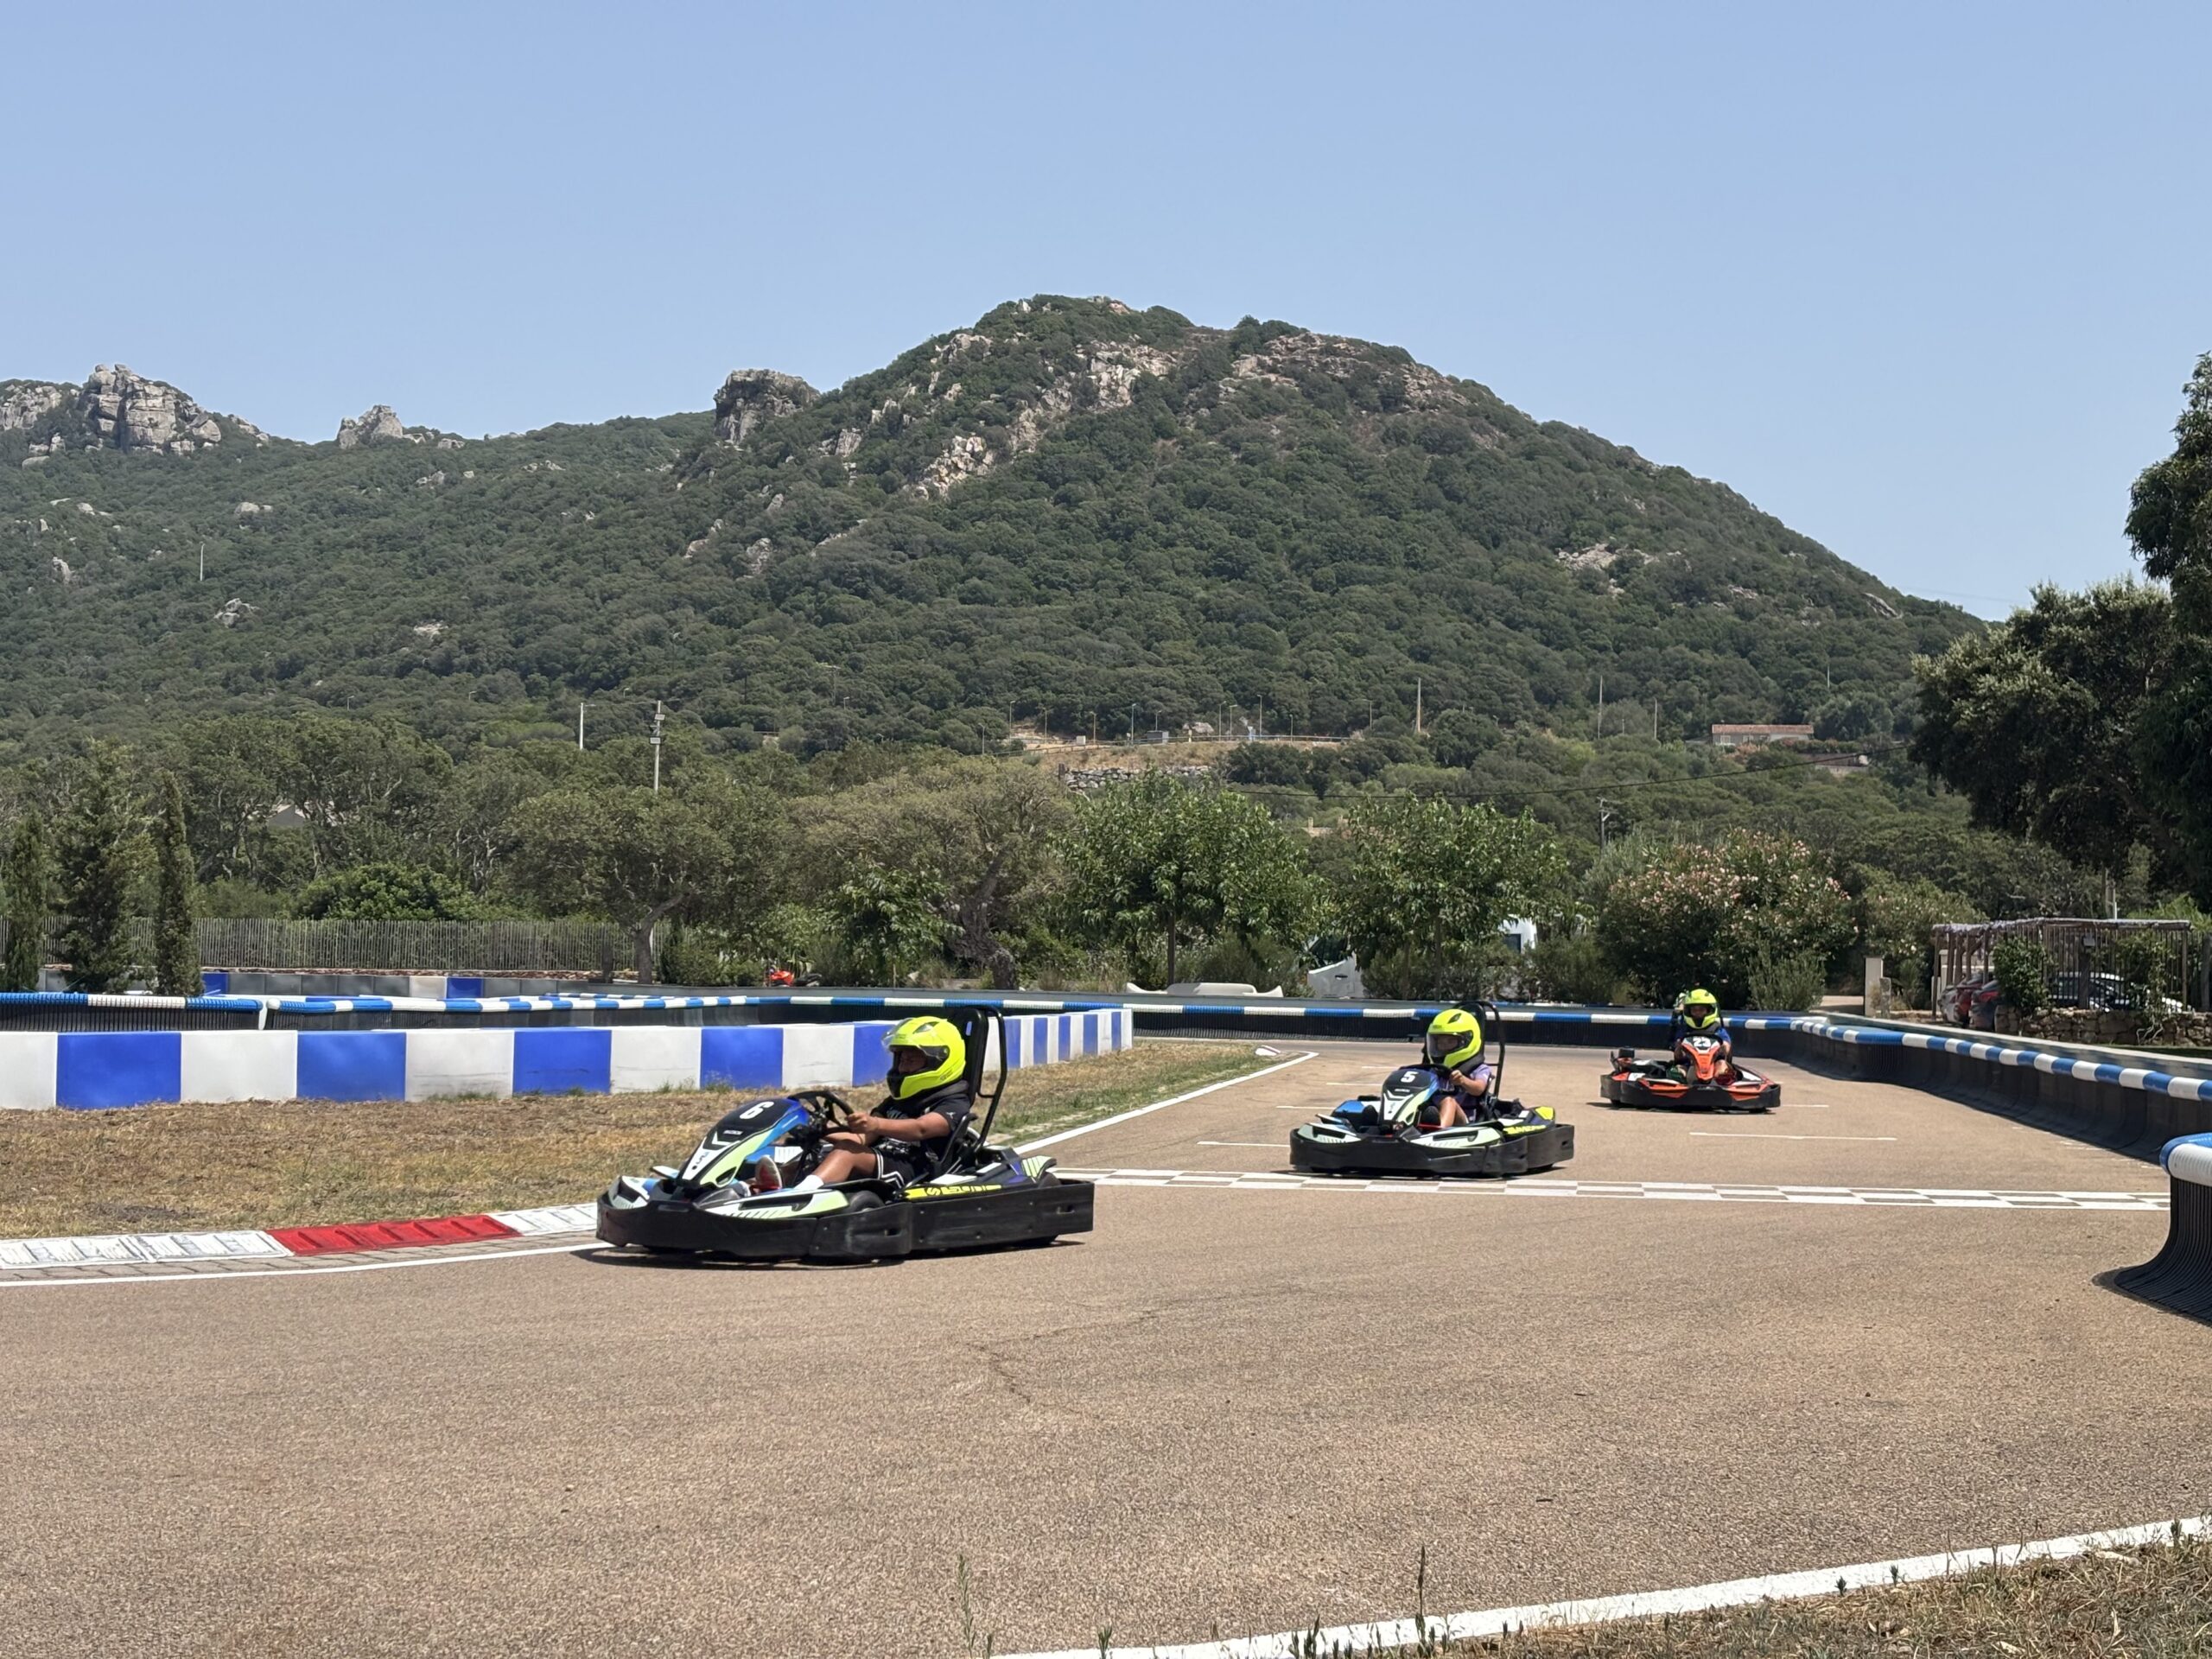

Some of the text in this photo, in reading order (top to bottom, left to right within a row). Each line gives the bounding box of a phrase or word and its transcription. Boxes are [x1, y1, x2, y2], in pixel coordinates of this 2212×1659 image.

[1693, 1036, 1711, 1047] 23
[1401, 1071, 1419, 1083] 5
[740, 1101, 774, 1119] 6
